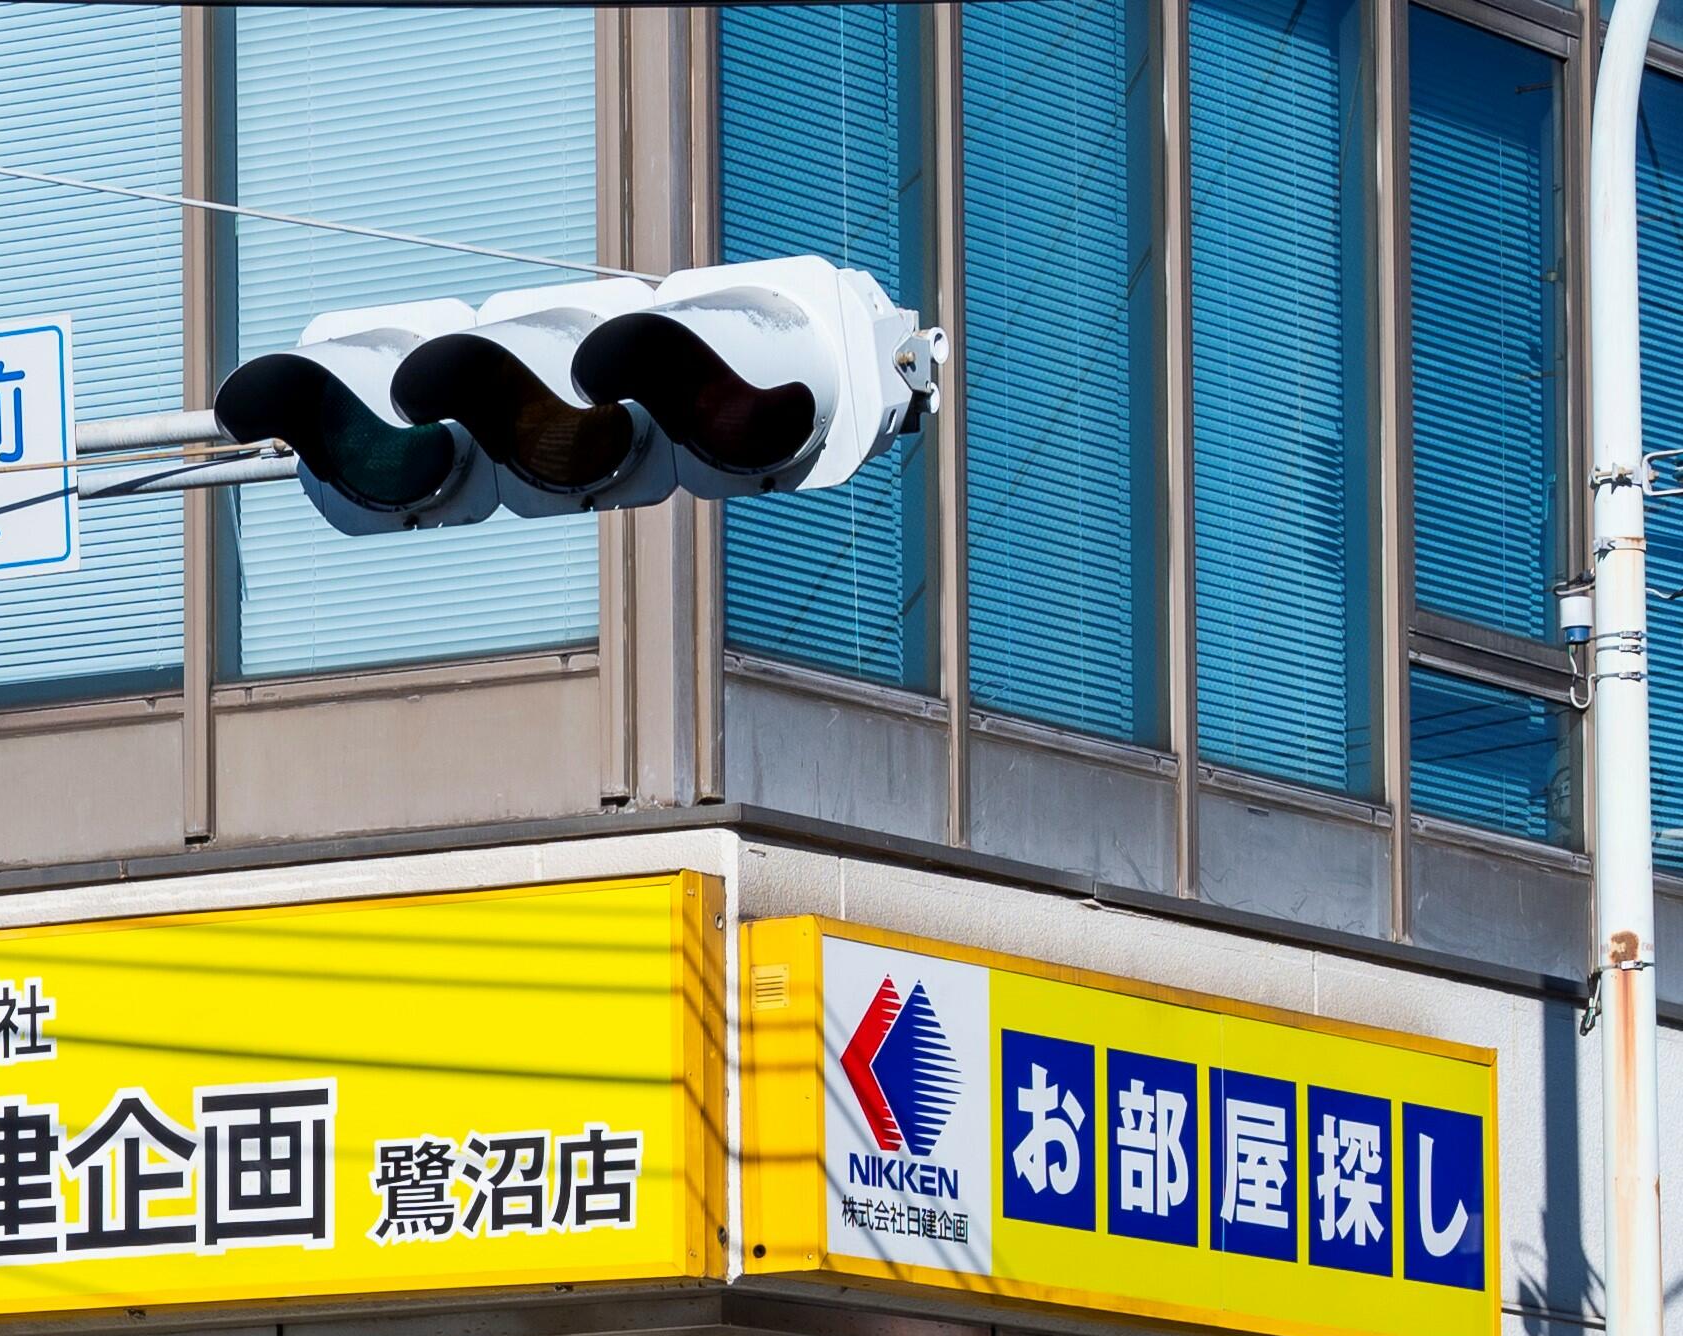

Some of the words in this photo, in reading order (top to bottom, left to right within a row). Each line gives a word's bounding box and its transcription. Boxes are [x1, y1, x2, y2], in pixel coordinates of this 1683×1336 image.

[375, 1129, 639, 1240] 鷺沼店
[848, 1151, 960, 1201] NIKKEN
[1011, 1062, 1469, 1258] お部屋探し
[841, 1195, 970, 1247] 株式会社日建企画
